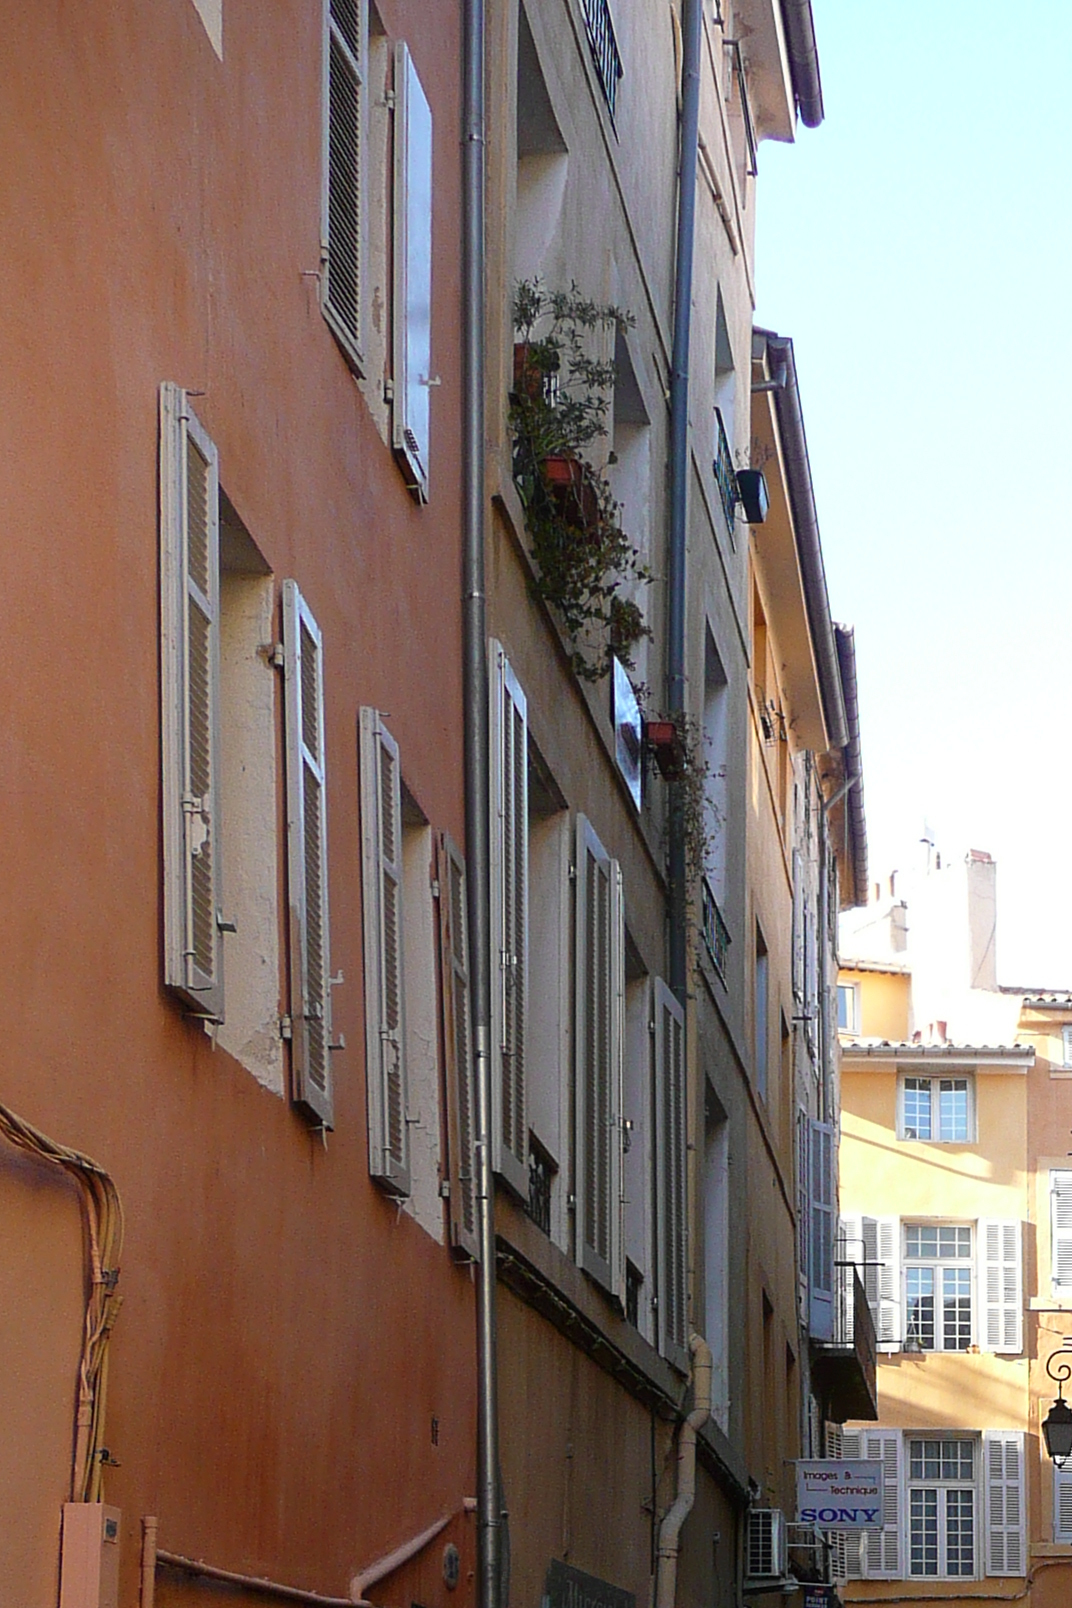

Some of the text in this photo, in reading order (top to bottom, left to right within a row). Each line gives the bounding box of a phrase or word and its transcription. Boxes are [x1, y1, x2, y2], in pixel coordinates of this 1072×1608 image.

[803, 1470, 838, 1481] Images
[830, 1485, 878, 1497] Technique
[801, 1508, 879, 1522] SONY
